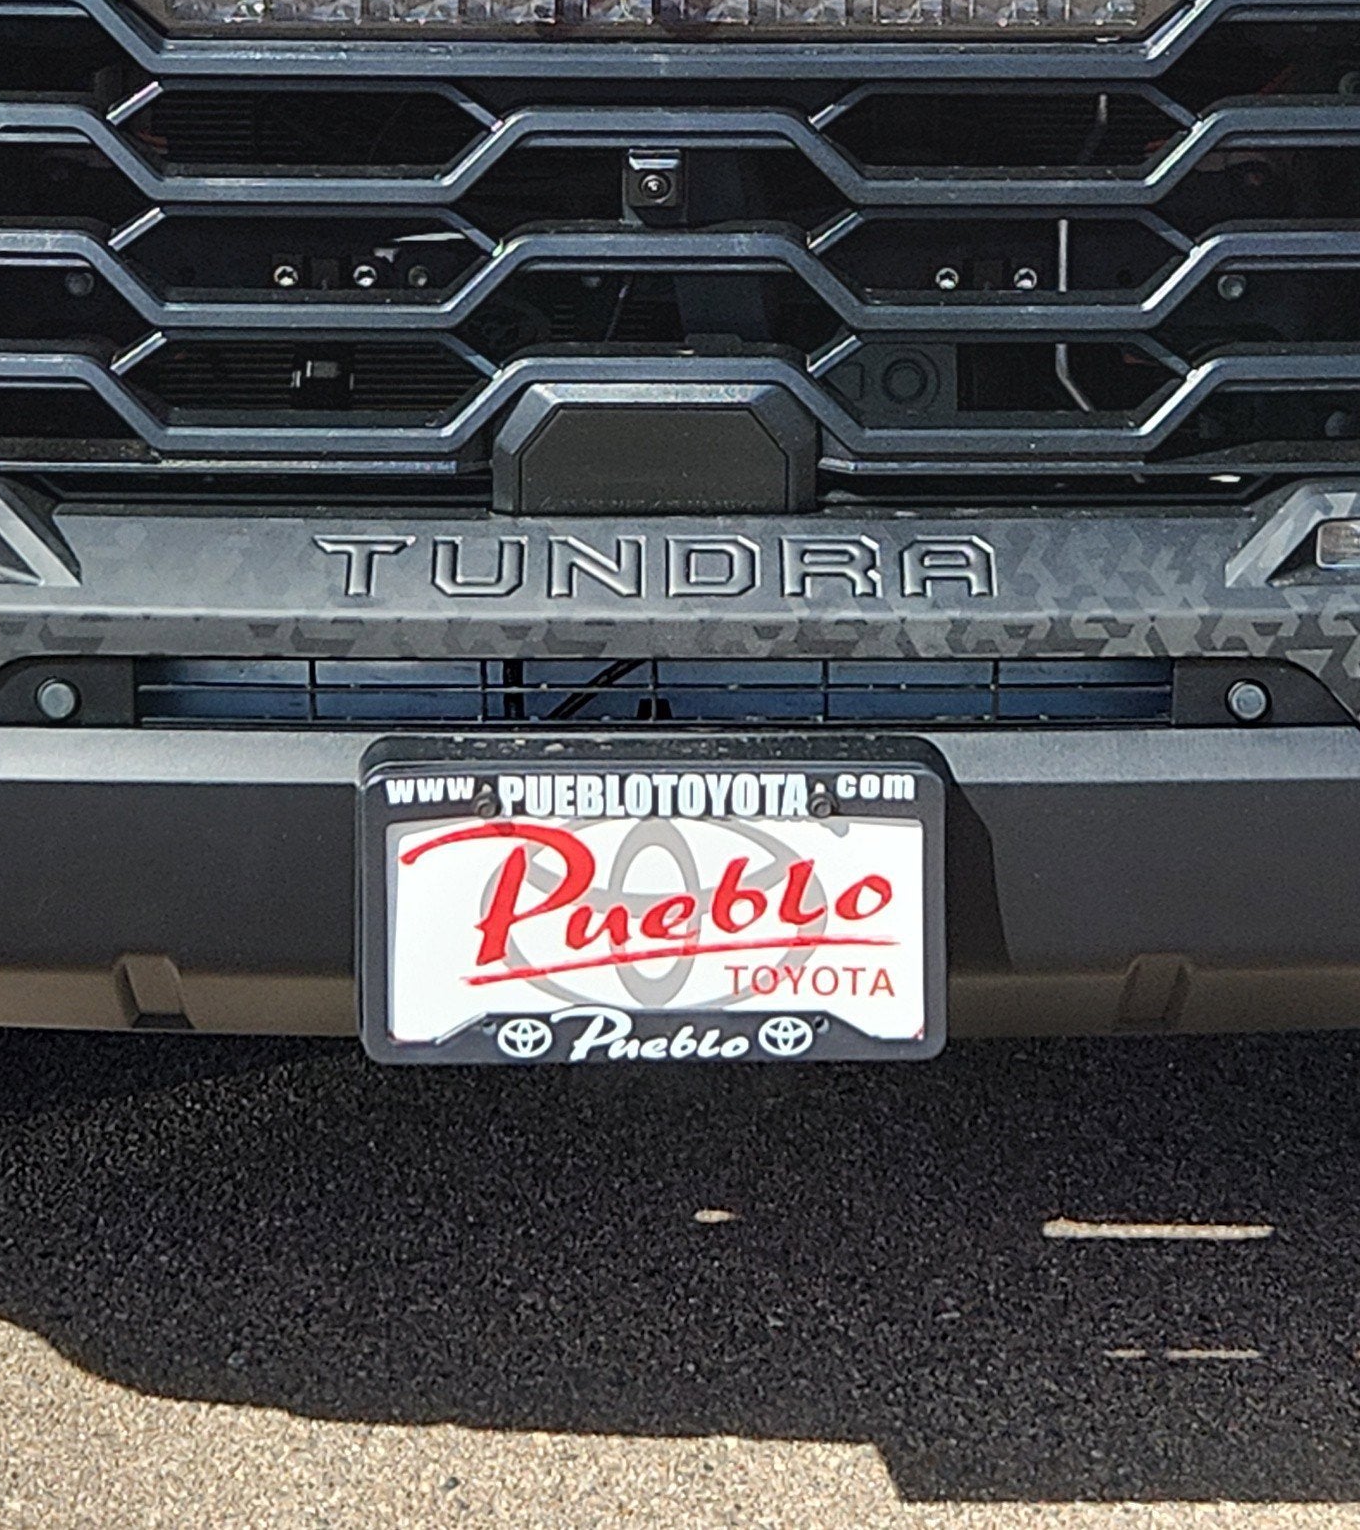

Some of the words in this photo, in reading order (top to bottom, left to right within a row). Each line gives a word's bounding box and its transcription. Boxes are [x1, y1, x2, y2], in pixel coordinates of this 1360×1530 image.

[313, 534, 998, 598] TUNDRA
[400, 822, 894, 966] Pueblo
[725, 964, 896, 997] TOYOTA
[549, 1005, 750, 1062] Pueblo
